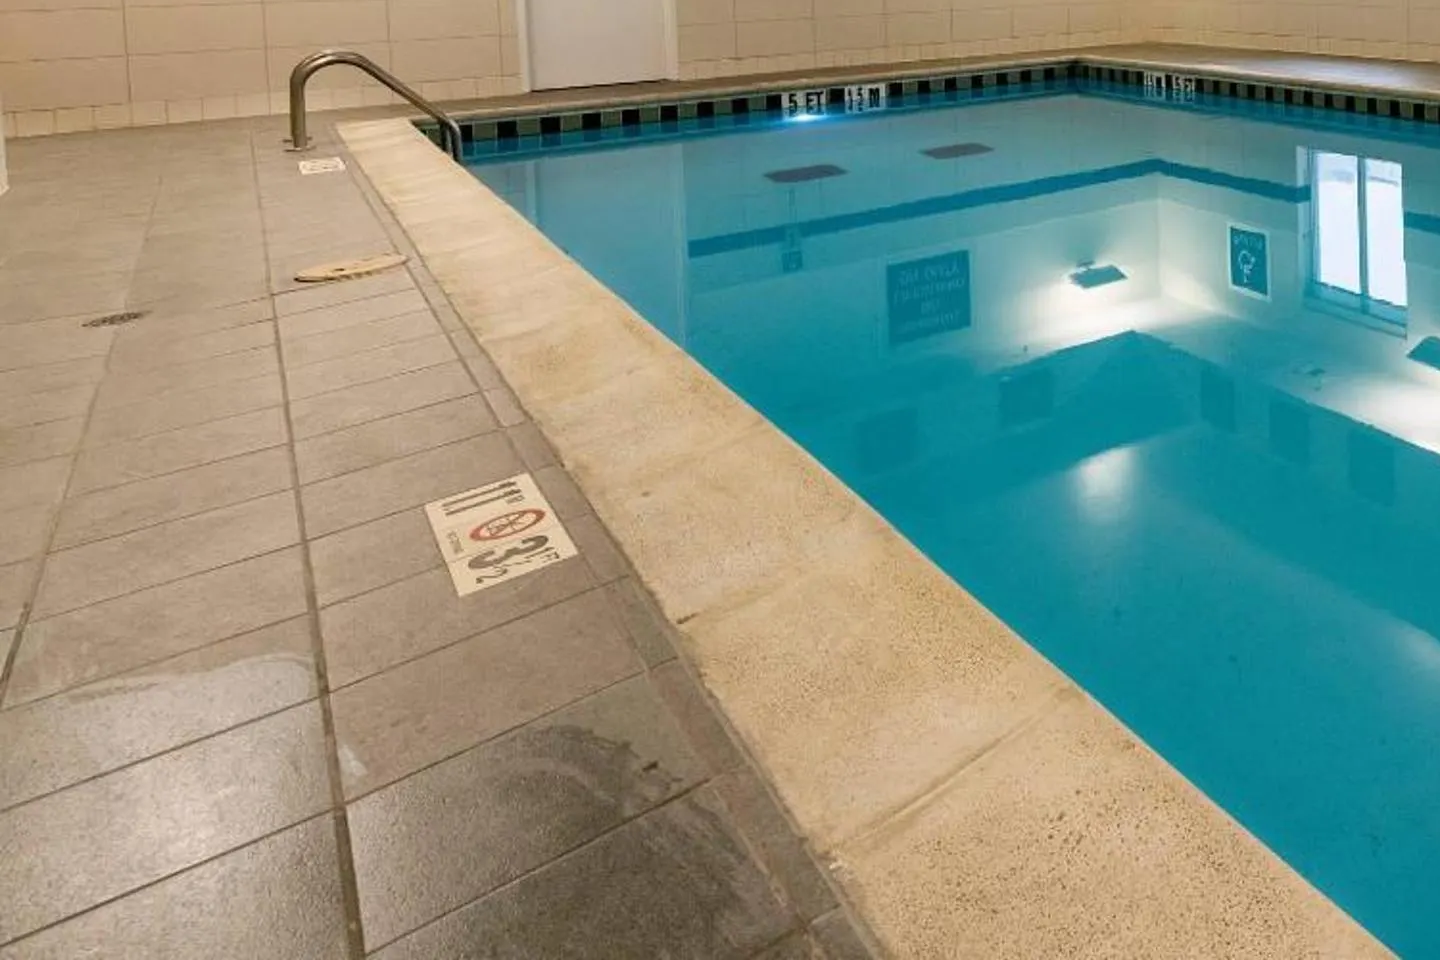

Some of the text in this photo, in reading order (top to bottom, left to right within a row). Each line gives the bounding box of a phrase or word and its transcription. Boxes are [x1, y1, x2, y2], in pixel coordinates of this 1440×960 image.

[788, 91, 824, 107] 5 FT
[468, 535, 549, 569] 3
